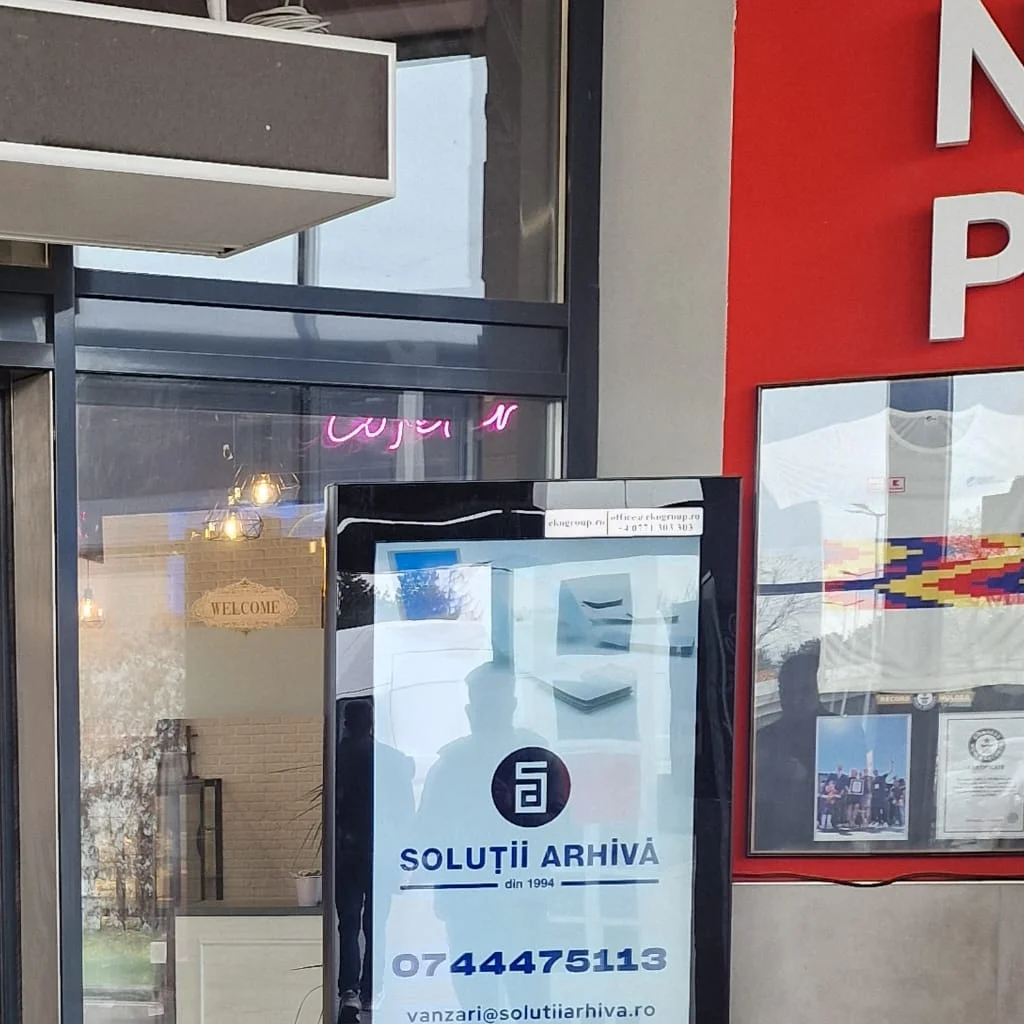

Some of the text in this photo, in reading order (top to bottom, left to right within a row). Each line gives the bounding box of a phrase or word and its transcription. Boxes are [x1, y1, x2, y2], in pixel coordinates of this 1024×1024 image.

[211, 600, 280, 616] WELCOME
[504, 878, 555, 889] din 1994
[392, 947, 667, 978] 0744475113
[407, 1002, 656, 1024] vanzari@solutiiarhiva.ro
